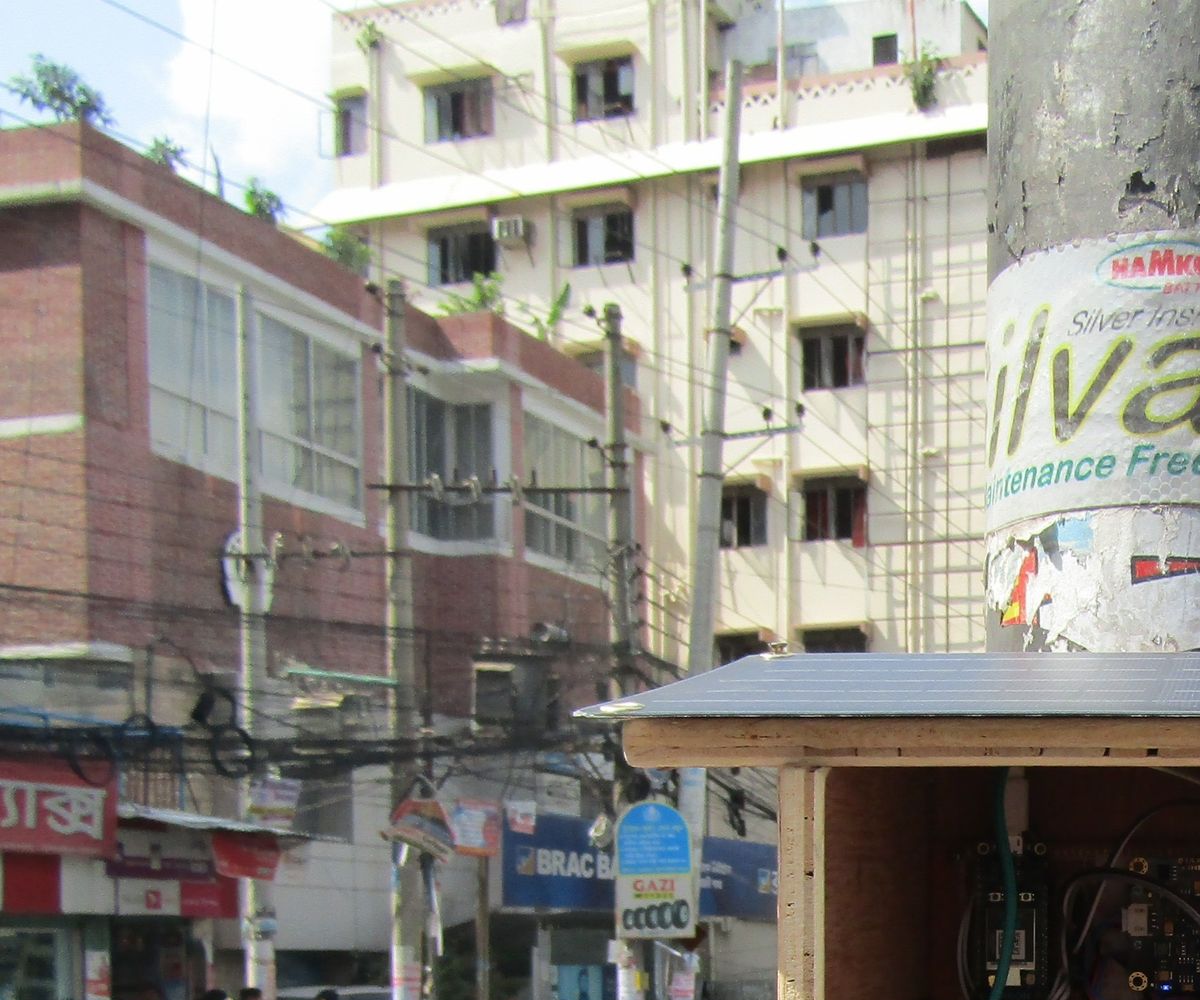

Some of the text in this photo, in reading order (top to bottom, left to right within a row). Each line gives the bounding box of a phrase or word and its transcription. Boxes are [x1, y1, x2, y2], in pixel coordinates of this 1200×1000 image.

[1068, 307, 1145, 337] Silver
[986, 454, 1116, 509] aintenance
[537, 847, 594, 879] BRAC
[633, 878, 676, 893] GAZI
